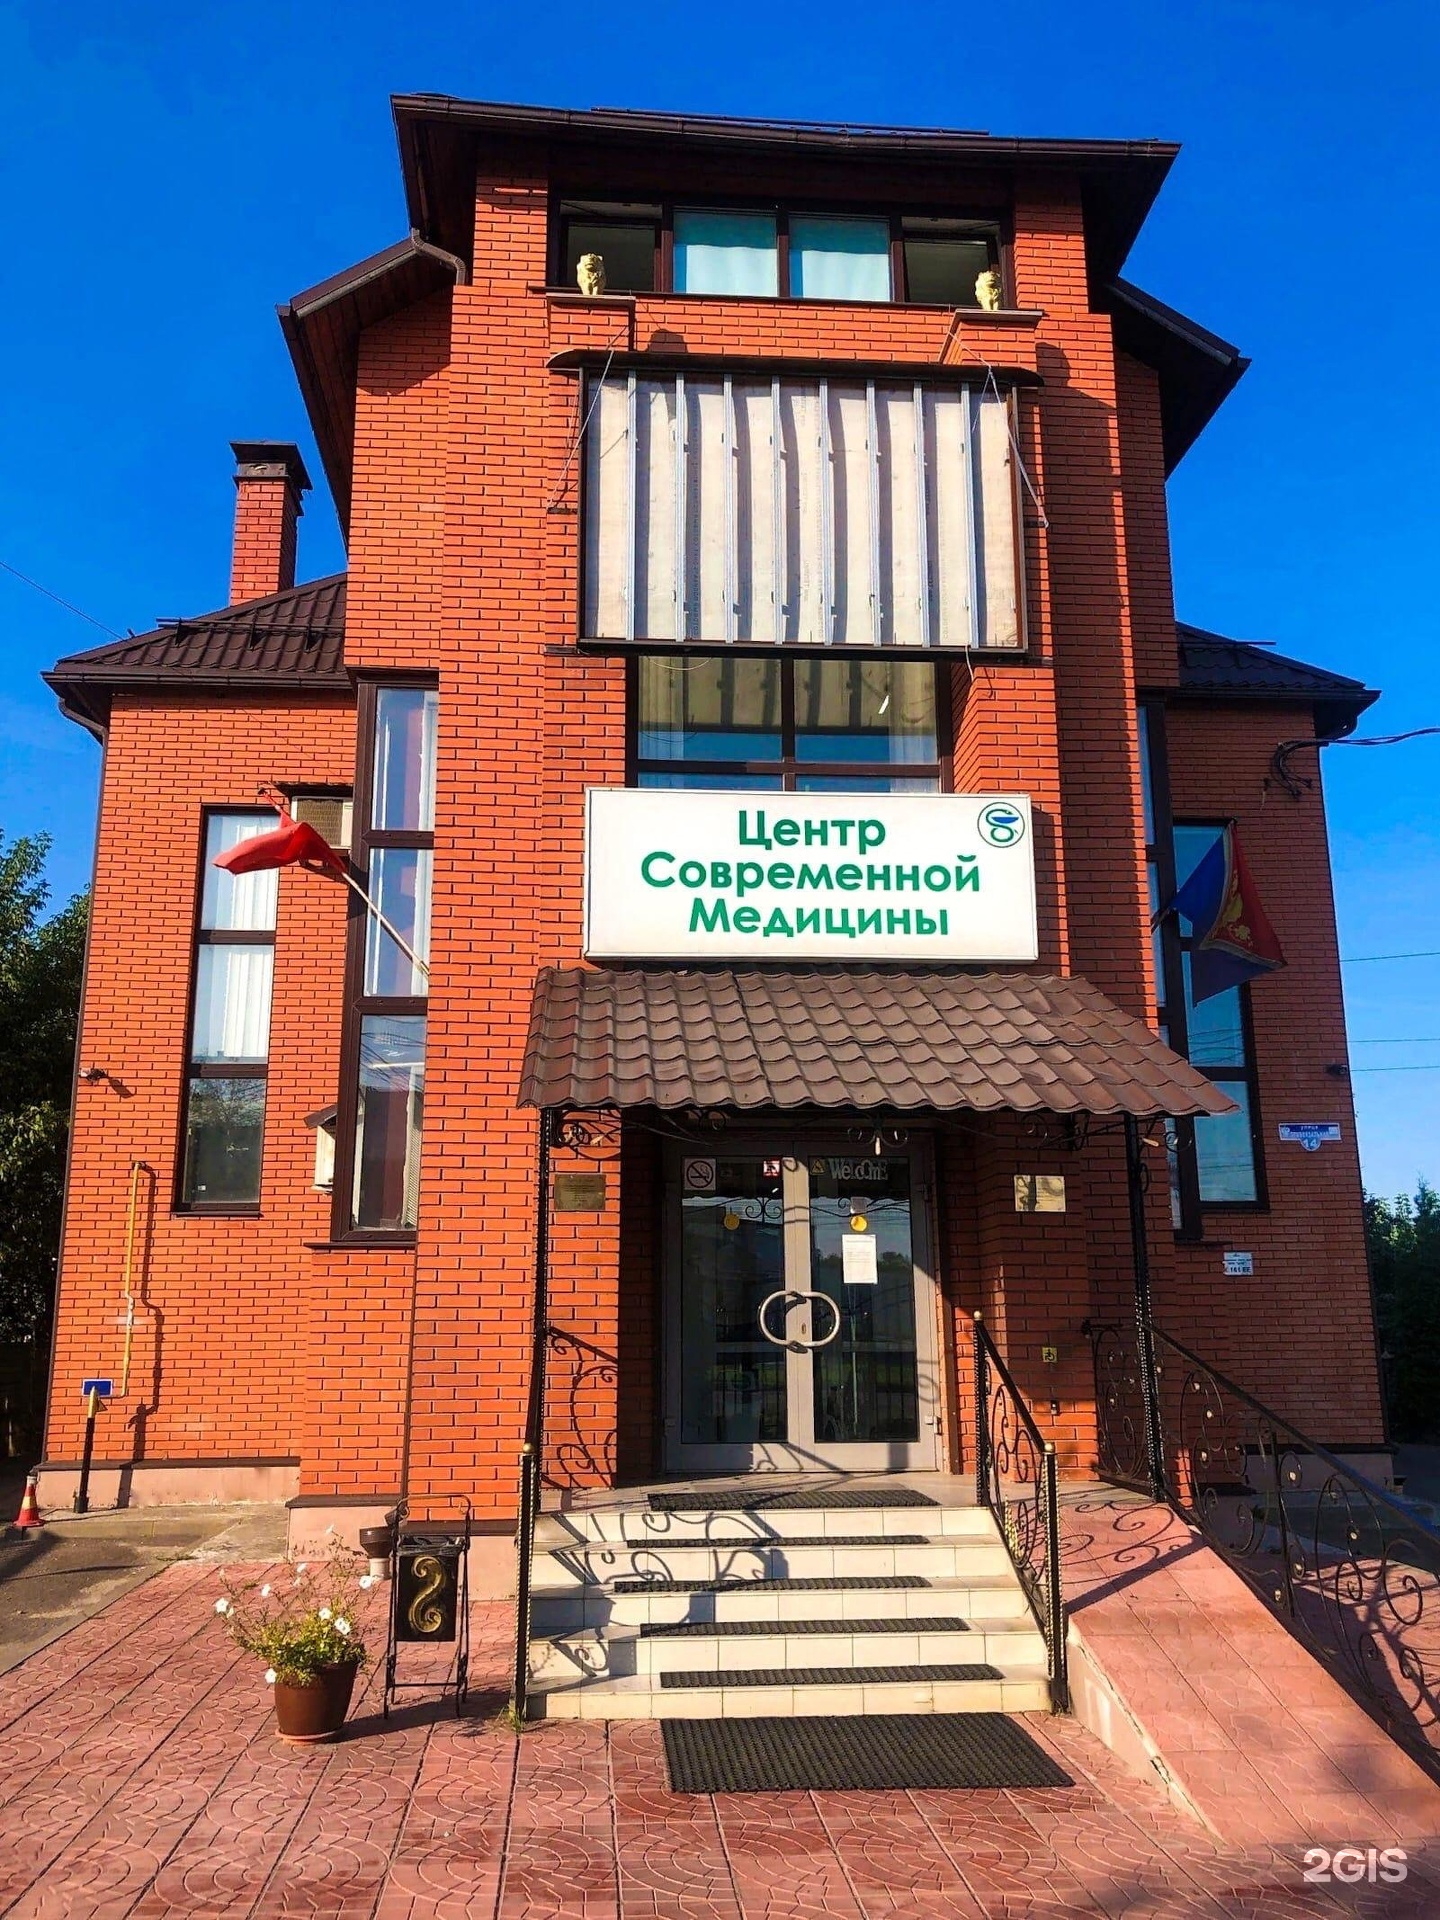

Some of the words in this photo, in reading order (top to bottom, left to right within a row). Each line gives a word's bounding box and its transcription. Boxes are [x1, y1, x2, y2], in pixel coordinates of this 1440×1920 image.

[738, 809, 886, 855] Центр
[641, 850, 981, 898] Современной
[688, 896, 949, 938] Медицины
